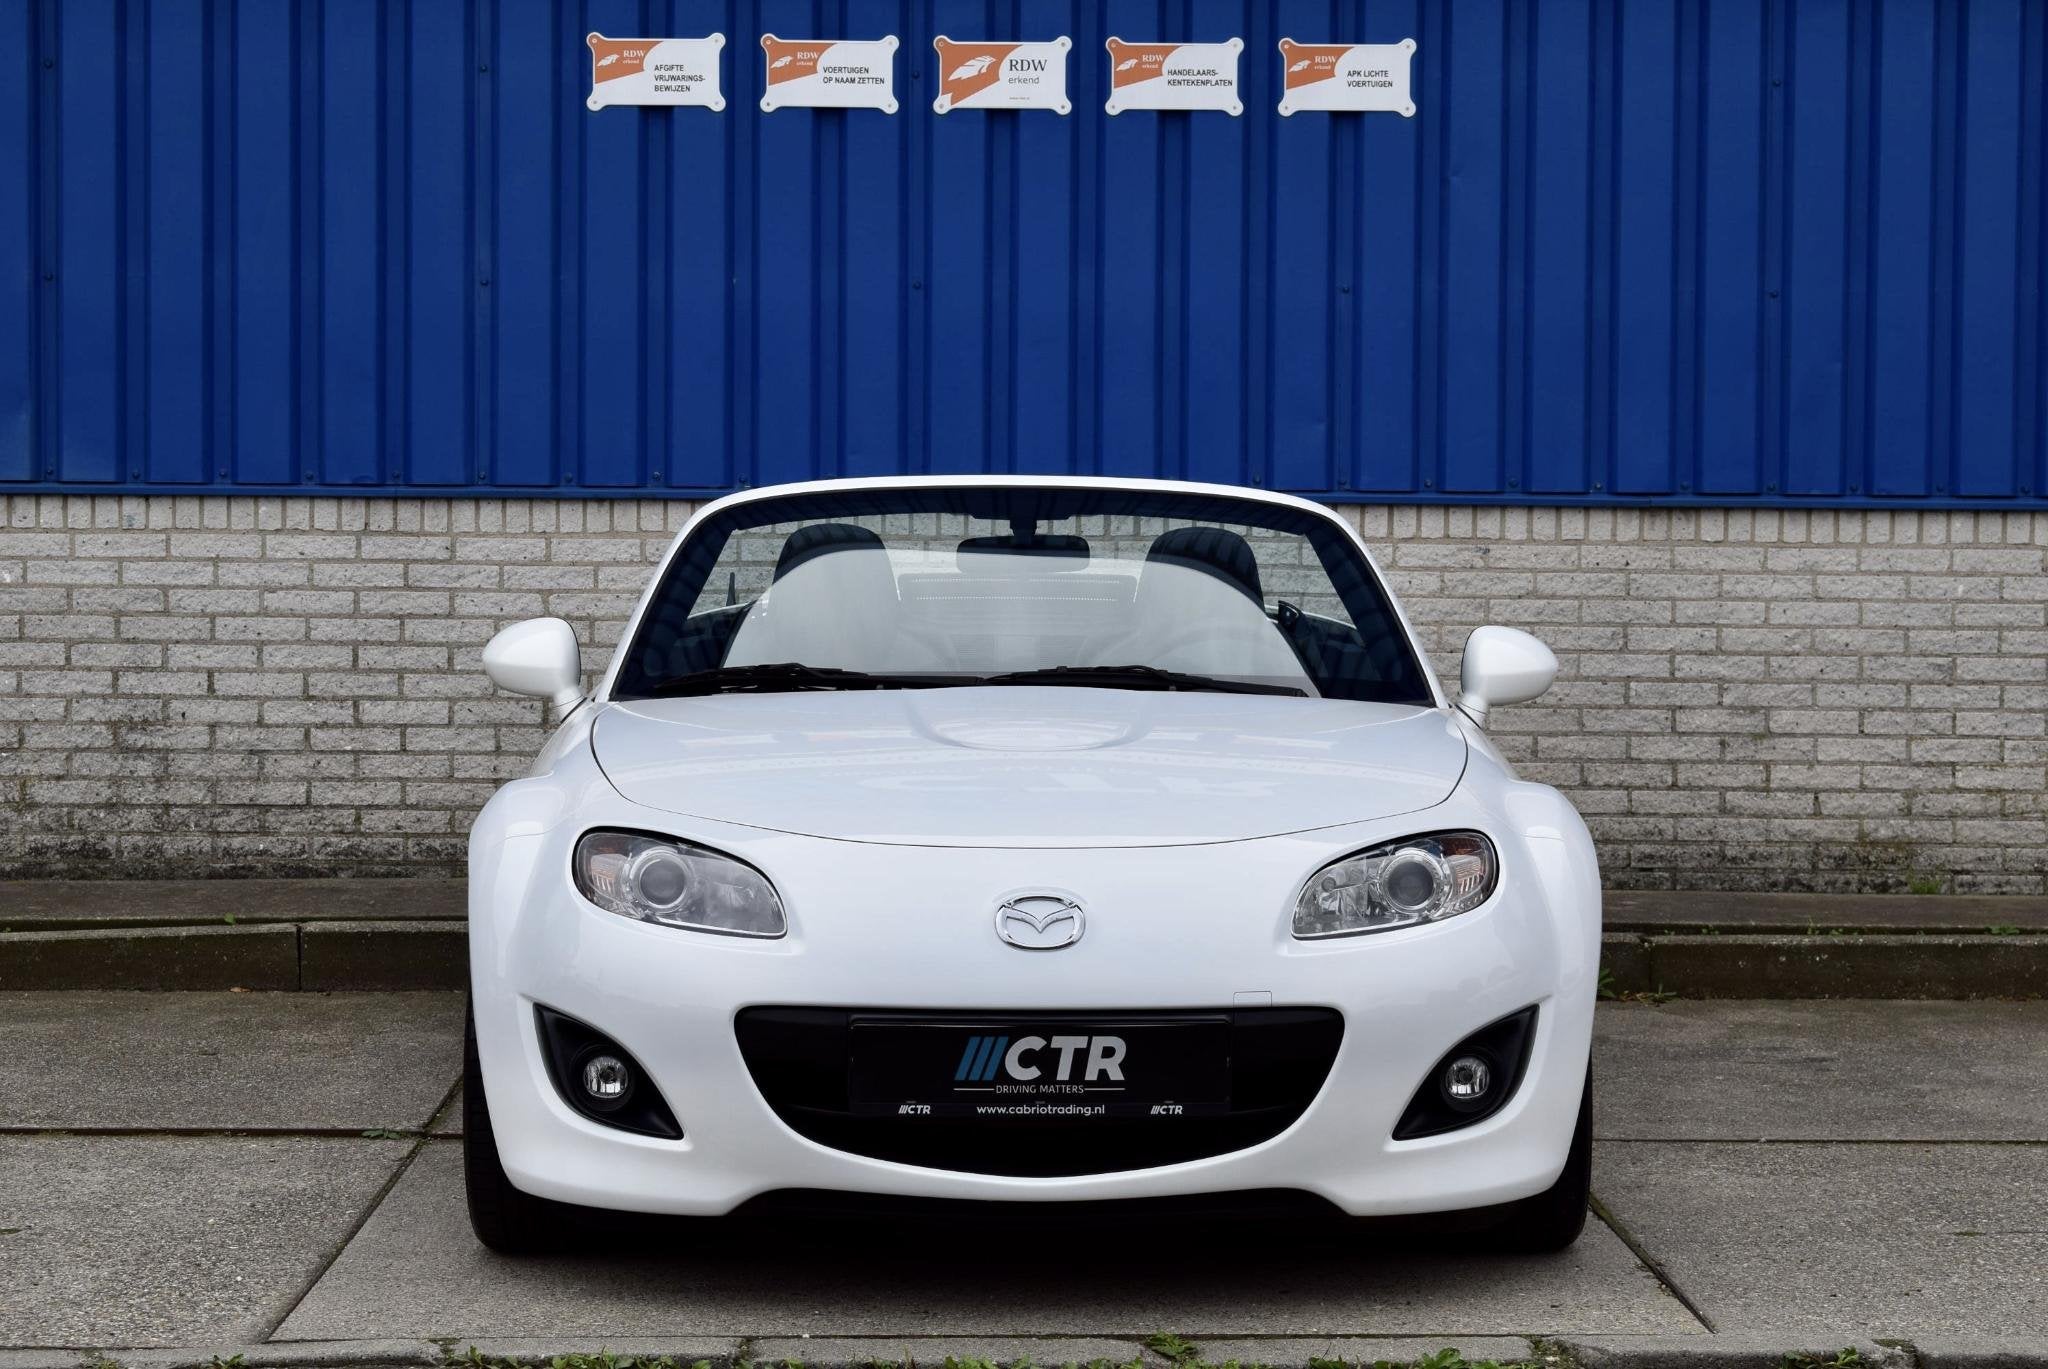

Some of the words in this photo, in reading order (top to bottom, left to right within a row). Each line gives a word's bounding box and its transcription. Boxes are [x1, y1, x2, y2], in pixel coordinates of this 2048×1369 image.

[623, 50, 645, 58] RDW
[797, 51, 820, 59] RDW
[1142, 54, 1164, 62] RDW
[1314, 55, 1336, 63] RDW
[1009, 59, 1048, 72] RDW
[822, 66, 870, 74] VOERTUIGEN
[1347, 70, 1362, 78] APK
[1363, 70, 1389, 78] LICHTE
[1008, 76, 1040, 85] erkend
[1167, 79, 1233, 87] KENTEKENPLATEN
[1347, 80, 1393, 88] VOERTUIGEN
[995, 1084, 1037, 1094] DRIVING
[1039, 1084, 1084, 1094] MATTERS
[976, 1104, 1105, 1117] www.cabriotrading.nl
